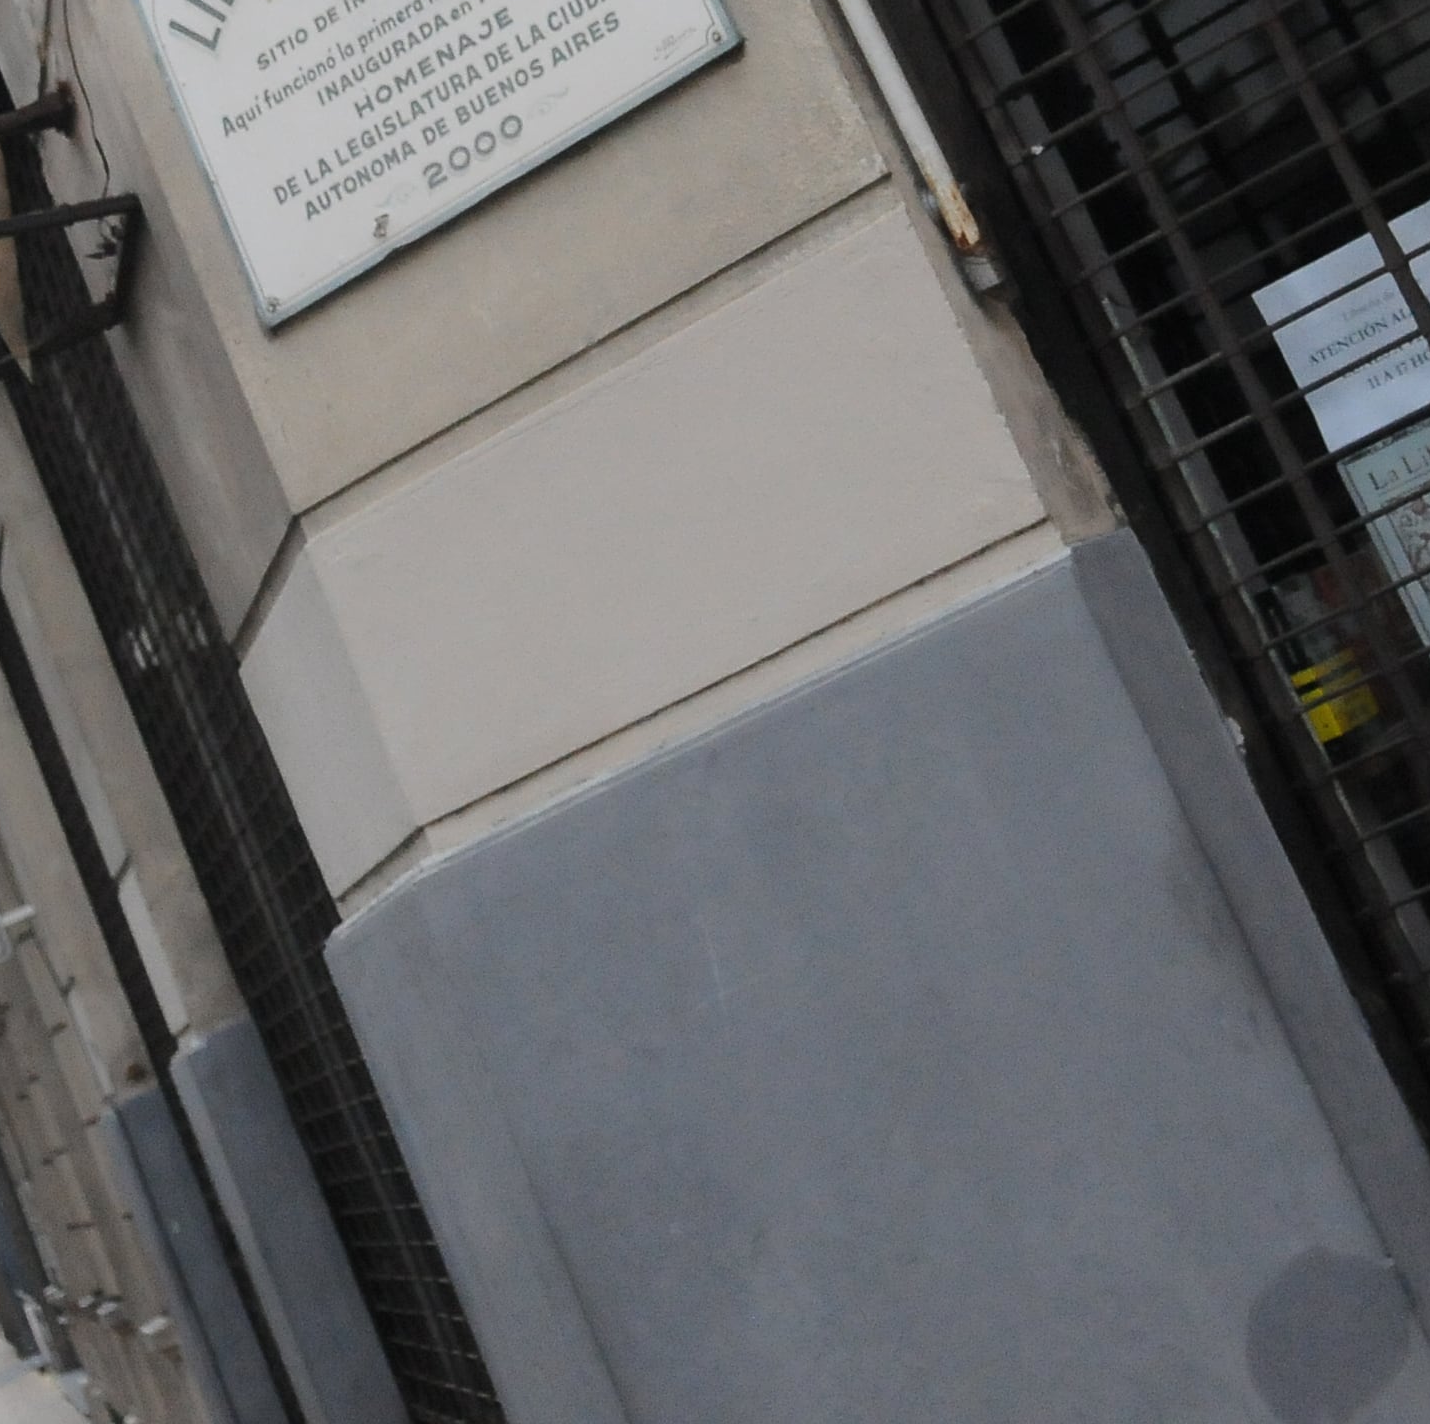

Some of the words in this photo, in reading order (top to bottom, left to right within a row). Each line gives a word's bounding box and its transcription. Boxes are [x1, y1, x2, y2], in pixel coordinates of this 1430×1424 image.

[220, 94, 264, 138] Aquí
[262, 46, 338, 111] funcionó
[334, 41, 356, 62] la
[255, 27, 310, 72] SITIO
[312, 5, 341, 34] DE
[315, 12, 451, 108] INAUGURADA
[449, 0, 474, 22] en
[353, 5, 515, 120] HOMENAJE
[271, 174, 303, 207] DE
[302, 156, 334, 187] LA
[332, 63, 484, 168] LEGISLATURA
[482, 41, 515, 74] DE
[513, 22, 547, 54] LA
[304, 139, 418, 222] AUTONOMA
[420, 116, 451, 147] DE
[453, 57, 546, 127] BUENOS
[550, 10, 621, 69] AIRES
[421, 113, 525, 191] 2000
[1304, 314, 1389, 367] ATENCIÓN
